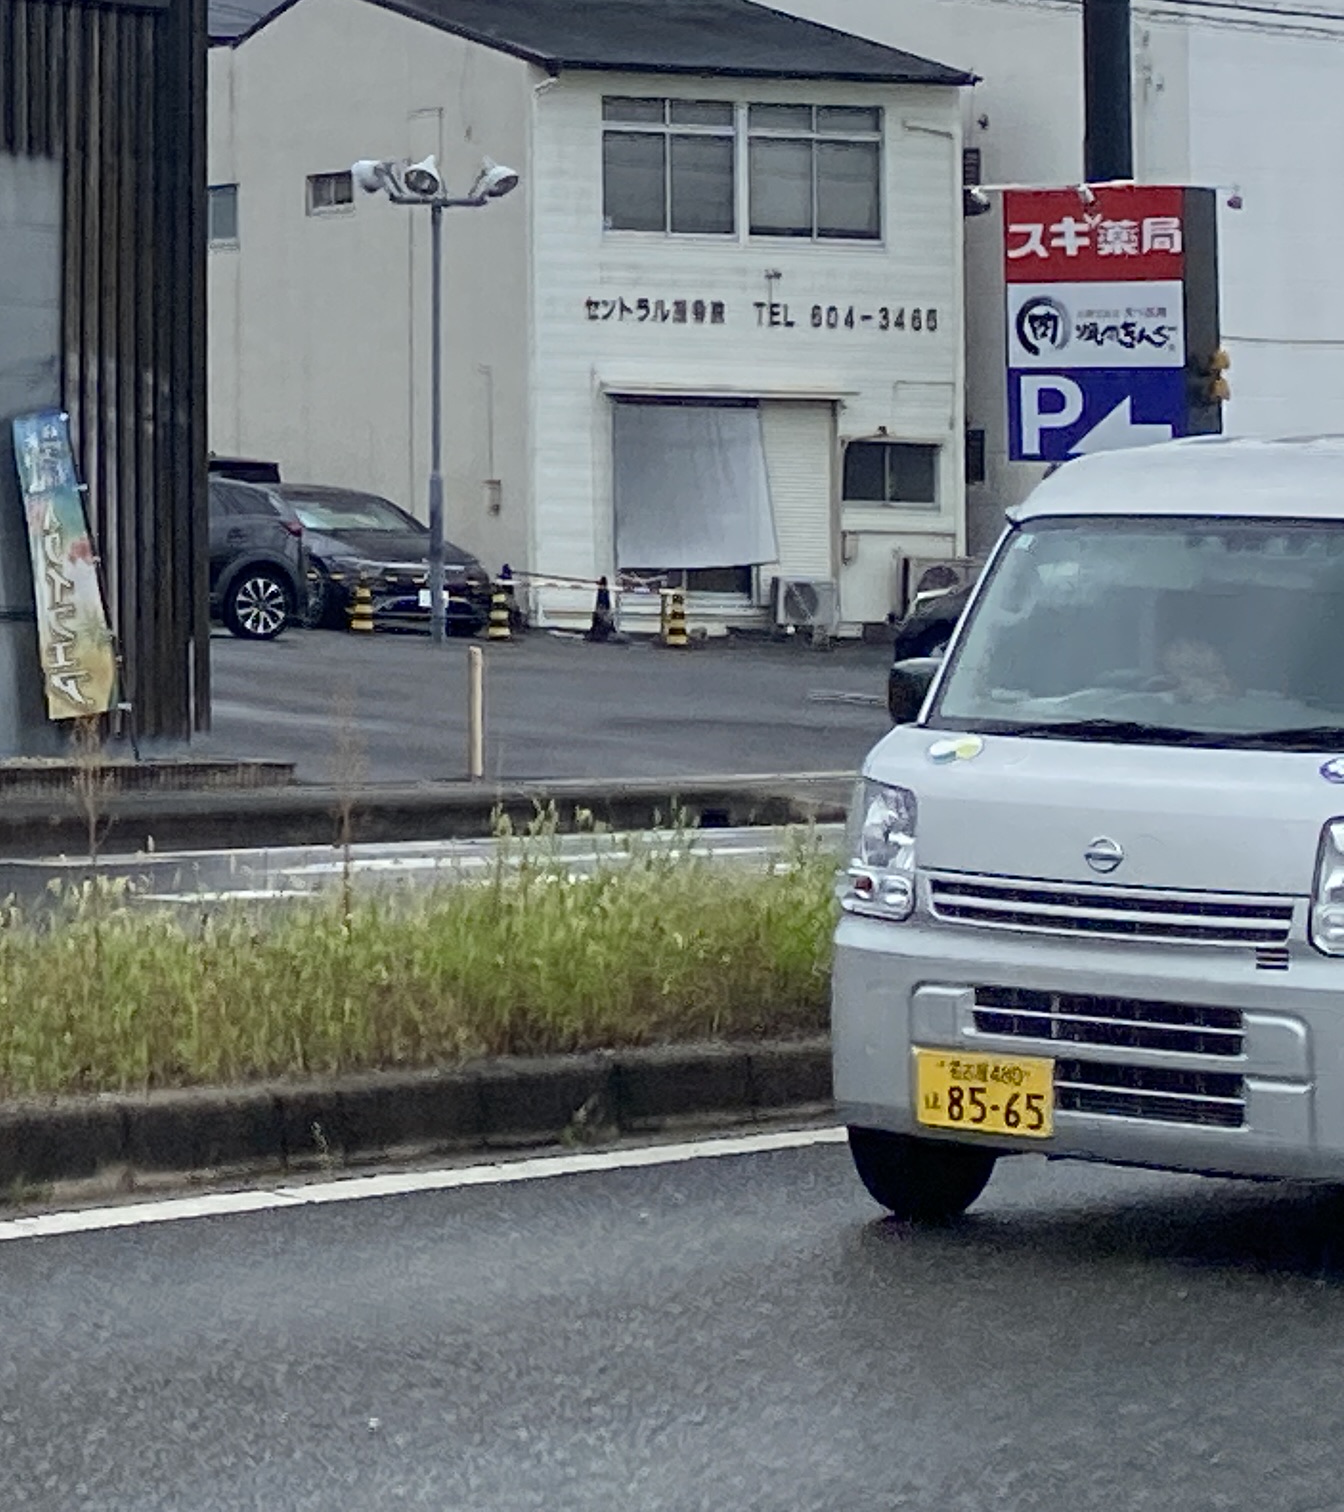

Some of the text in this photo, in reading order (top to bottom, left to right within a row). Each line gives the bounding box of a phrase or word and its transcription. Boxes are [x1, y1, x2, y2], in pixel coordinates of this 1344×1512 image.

[1007, 213, 1182, 259] スギ薬局
[753, 301, 795, 328] TEL
[1020, 374, 1084, 455] P
[948, 1086, 1044, 1130] 85-65
